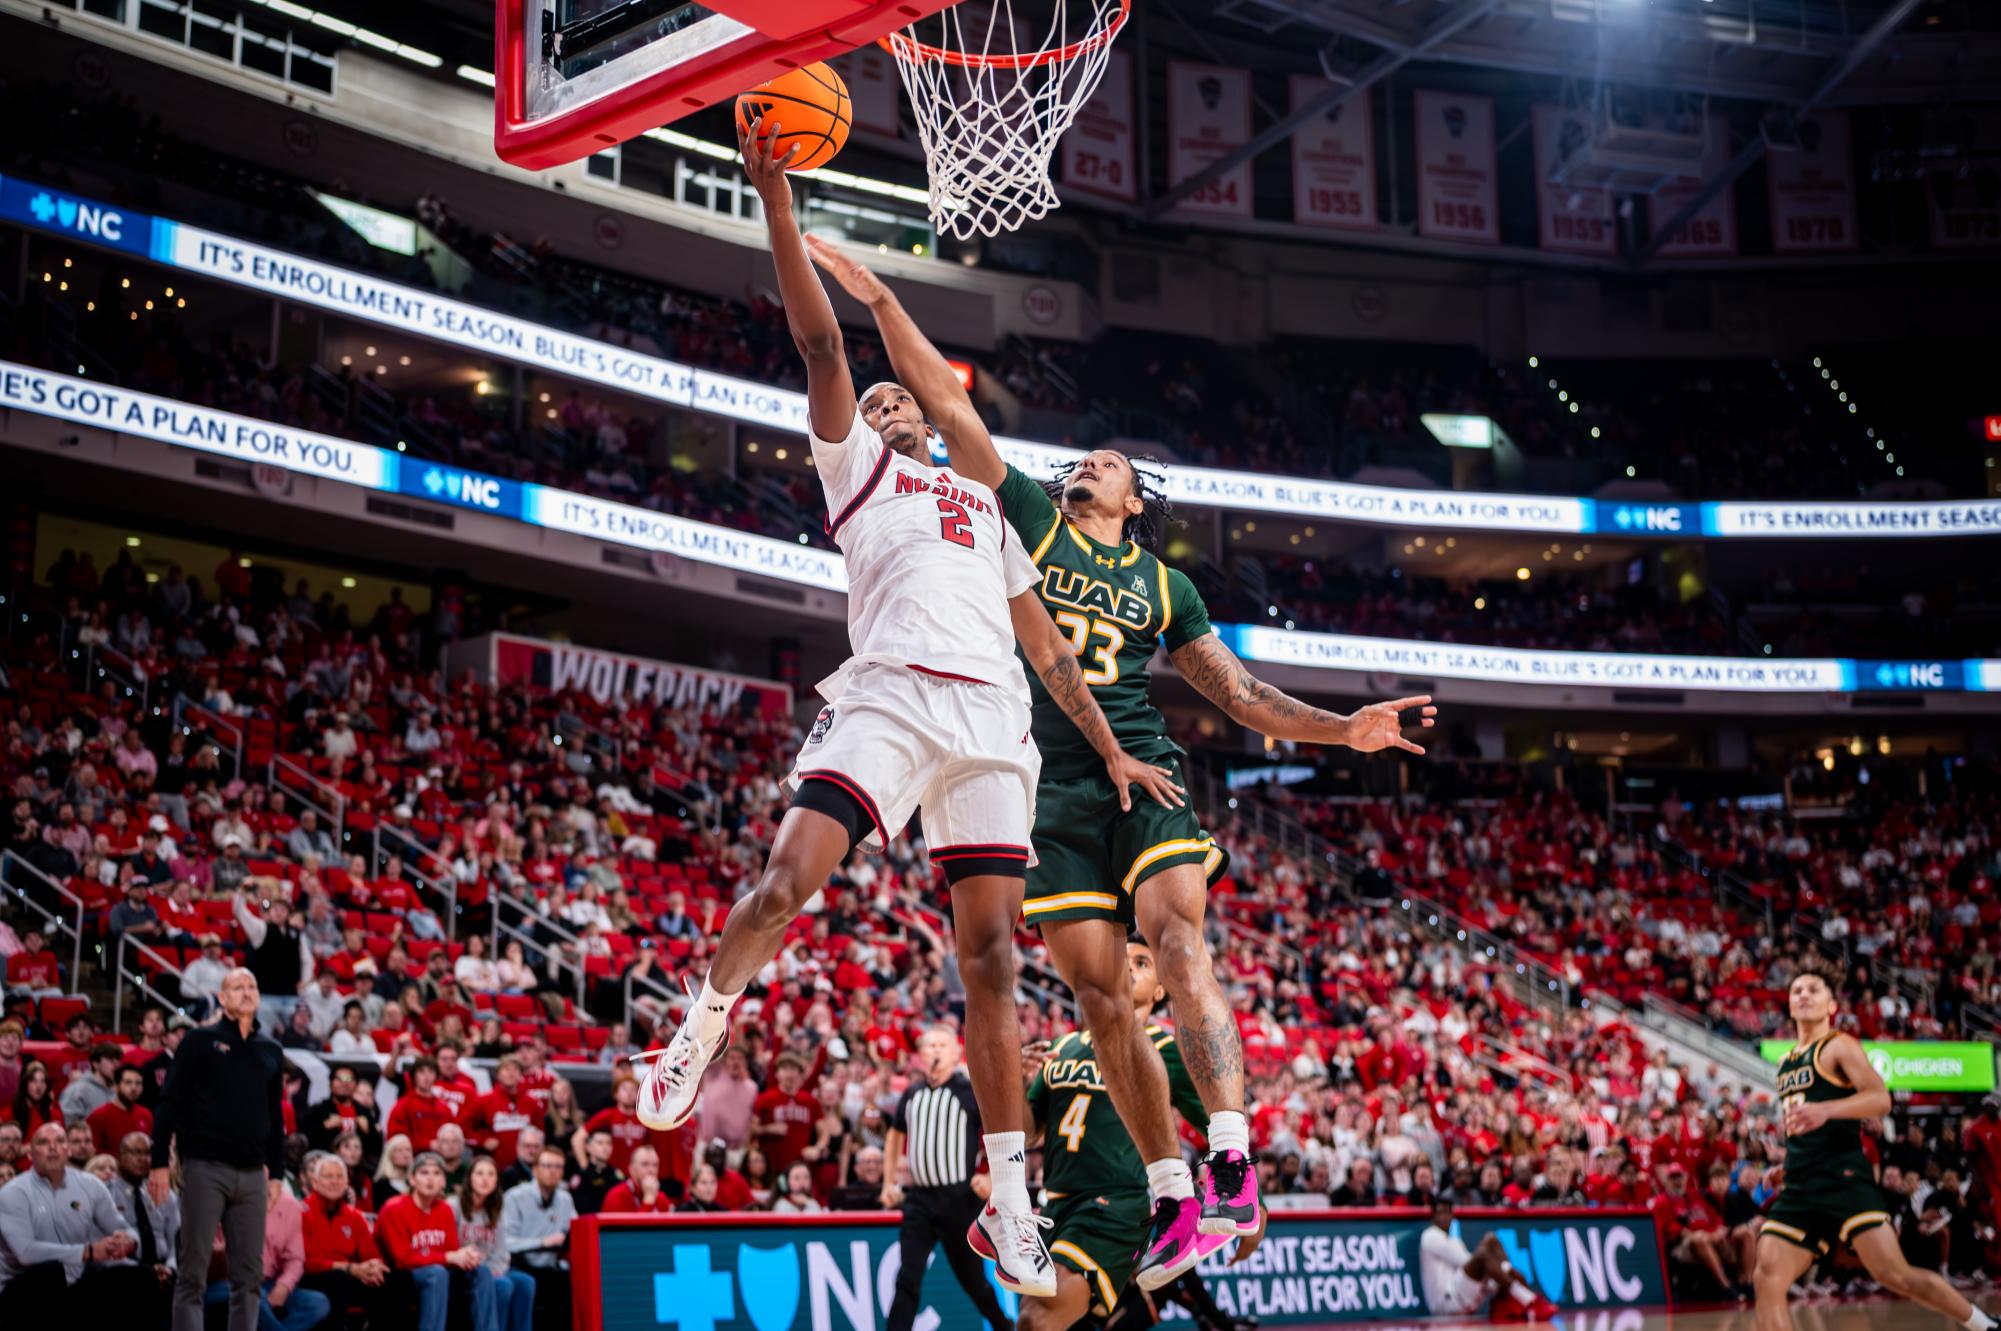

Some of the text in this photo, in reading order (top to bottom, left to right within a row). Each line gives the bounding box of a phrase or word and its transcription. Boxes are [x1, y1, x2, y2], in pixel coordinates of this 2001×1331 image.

[1183, 177, 1237, 206] 954
[1309, 188, 1362, 216] 1955
[77, 204, 123, 241] NC
[199, 241, 244, 273] IT'S
[252, 256, 426, 322] ENROLLMENT
[535, 335, 606, 373] BLUE'S
[612, 358, 655, 383] GOT
[660, 372, 673, 390] A
[679, 377, 737, 406] PLAN
[744, 391, 783, 414] FOR
[0, 372, 357, 474] E'S GOT A PLAN FOR YOU.
[462, 474, 500, 509] NC
[895, 471, 930, 494] NC
[1274, 486, 1339, 507] BLUE'S
[1346, 494, 1385, 511] GOT
[1391, 498, 1402, 513] A
[1410, 501, 1462, 518] PLAN
[1470, 503, 1510, 519] FOR
[1646, 506, 1682, 531] NC
[1739, 510, 1776, 528] IT'S
[1781, 509, 1931, 529] ENROLLMENT
[563, 501, 600, 528] IT'S
[608, 511, 750, 560] ENROLLMENT
[936, 498, 975, 550] 2
[1041, 565, 1152, 631] UAB
[1304, 641, 1440, 666] ENROLLMENT
[1531, 660, 1597, 675] BLUE'S
[1604, 663, 1644, 679] GOT
[1650, 665, 1664, 678] A
[1669, 665, 1721, 681] PLAN
[1727, 666, 1766, 681] FOR
[1910, 663, 1944, 687] NC
[551, 647, 748, 717] WOLFPACK
[1043, 1057, 1106, 1090] UA
[1893, 1055, 1963, 1078] CHICKEN
[1058, 1093, 1093, 1152] 4
[1301, 1234, 1406, 1273] SEASON.
[1564, 1225, 1643, 1304] NC
[1215, 1279, 1239, 1317] A
[1237, 1275, 1309, 1317] PLAN
[1309, 1274, 1361, 1313] FOR
[1359, 1273, 1421, 1310] YOU.
